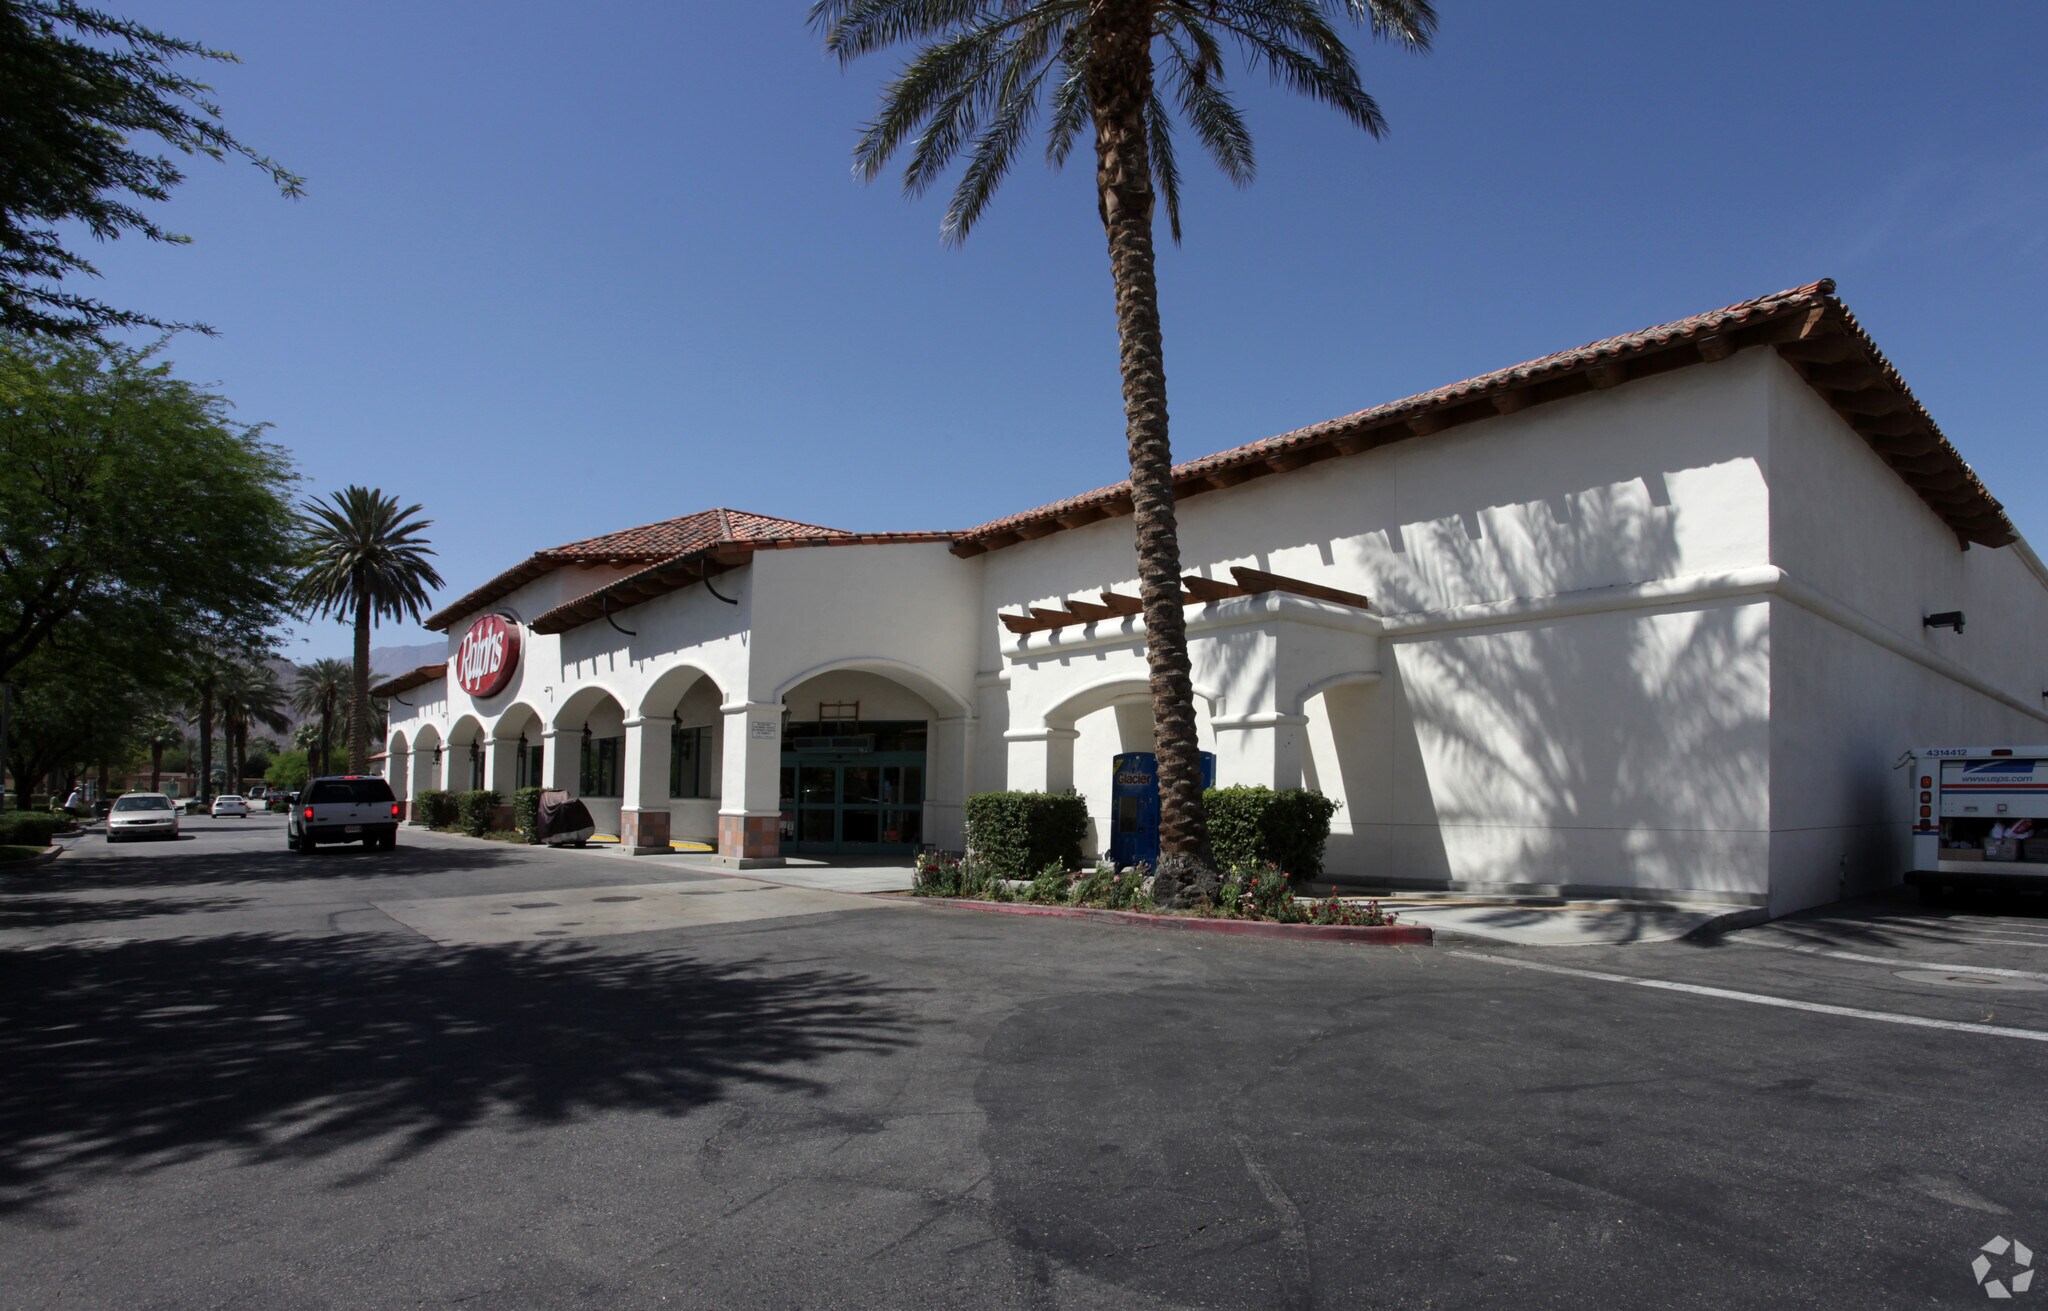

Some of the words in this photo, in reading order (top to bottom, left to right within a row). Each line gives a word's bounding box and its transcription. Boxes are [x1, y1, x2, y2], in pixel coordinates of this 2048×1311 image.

[460, 622, 504, 691] Ralphs
[1117, 773, 1151, 785] Glacier
[1961, 775, 2033, 783] www.usps.com
